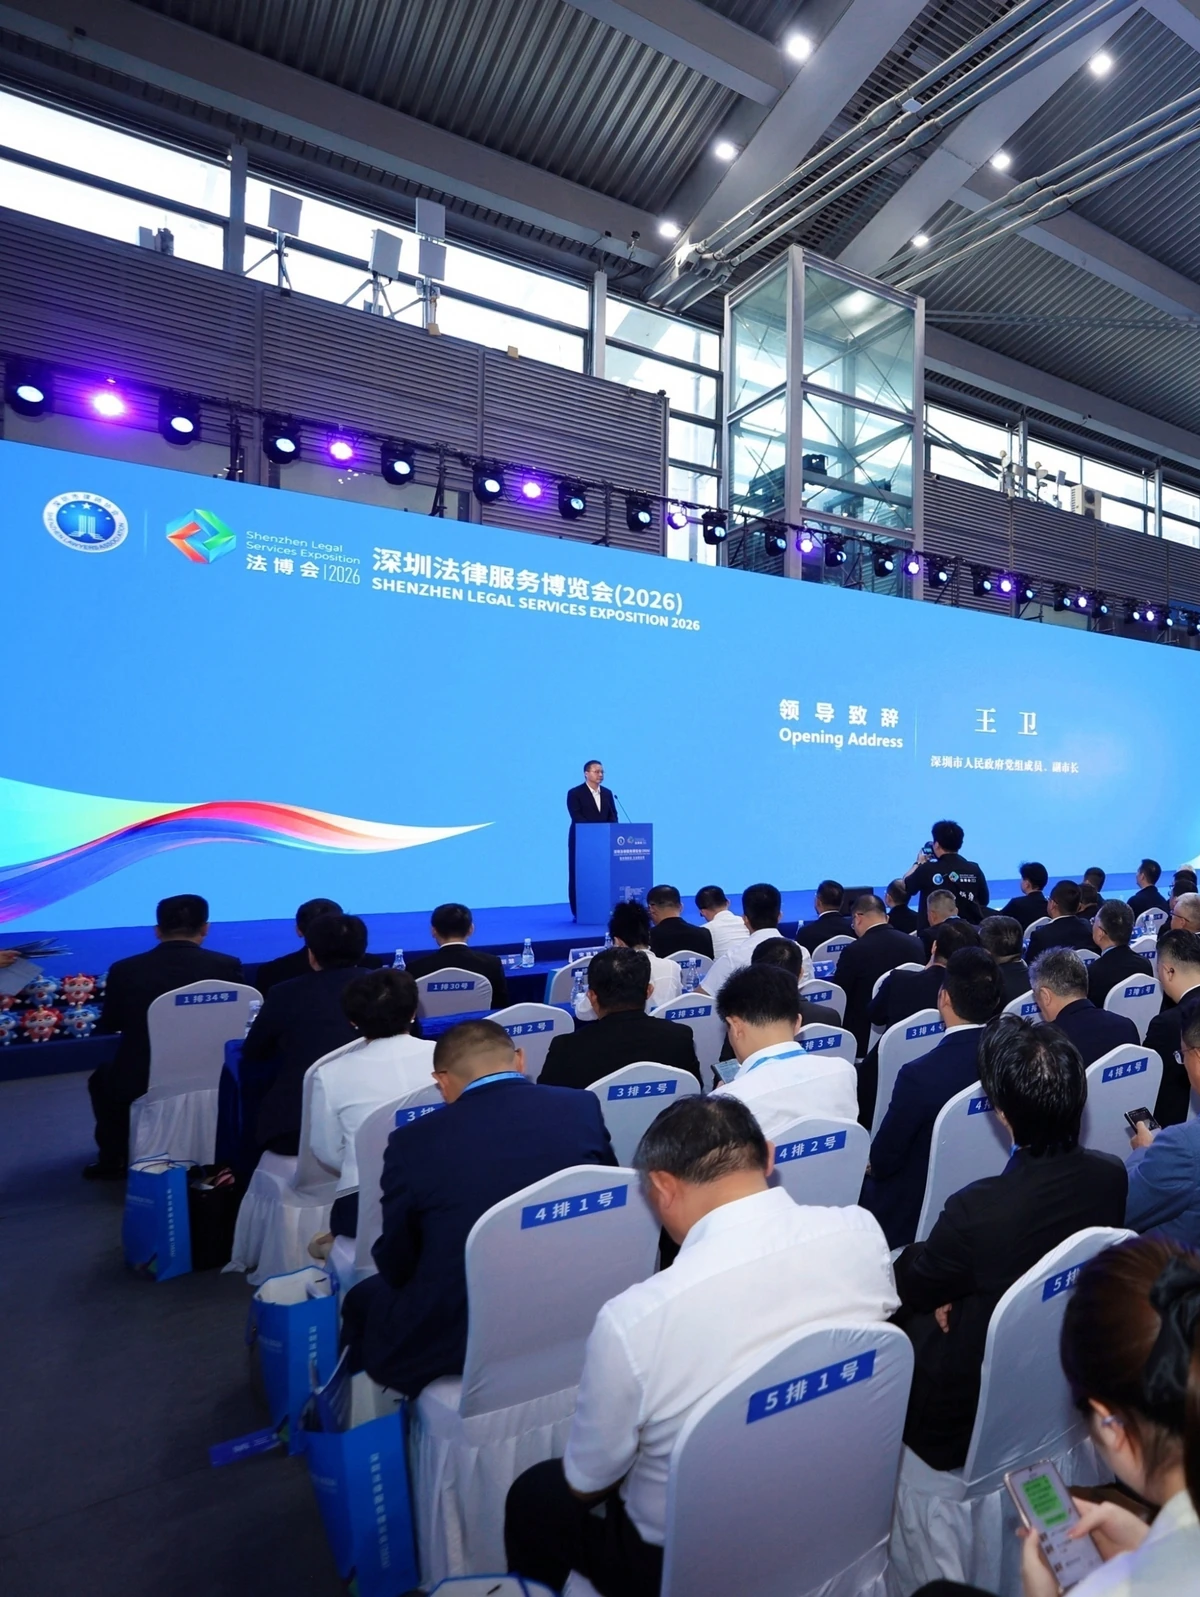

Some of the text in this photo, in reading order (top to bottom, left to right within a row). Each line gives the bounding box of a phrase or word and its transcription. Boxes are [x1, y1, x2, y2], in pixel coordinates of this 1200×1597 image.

[246, 530, 343, 553] Shenzhen Legal
[246, 541, 361, 565] Services Exposition
[246, 554, 361, 585] 法博会 2026
[372, 547, 684, 615] 深圳法律服务博览会(2026)
[372, 577, 701, 631] SHENZHEN LEGAL SERVICES EXPOSITION 2026
[779, 698, 899, 728] 领导致辞
[974, 707, 1039, 736] 王卫
[779, 727, 904, 751] Opening Address
[930, 755, 1079, 773] 深圳市人民政府党组成员、副市长
[184, 992, 230, 1004] 1排34号
[433, 982, 468, 991] 1排30号
[671, 1008, 706, 1019] 2排3号
[803, 1037, 835, 1051] 排3号
[1107, 1062, 1142, 1078] 4排4号
[616, 1082, 668, 1097] 3排2号
[779, 1135, 837, 1159] 4排2号
[535, 1191, 614, 1221] 4排1号
[764, 1360, 859, 1411] 5排1号
